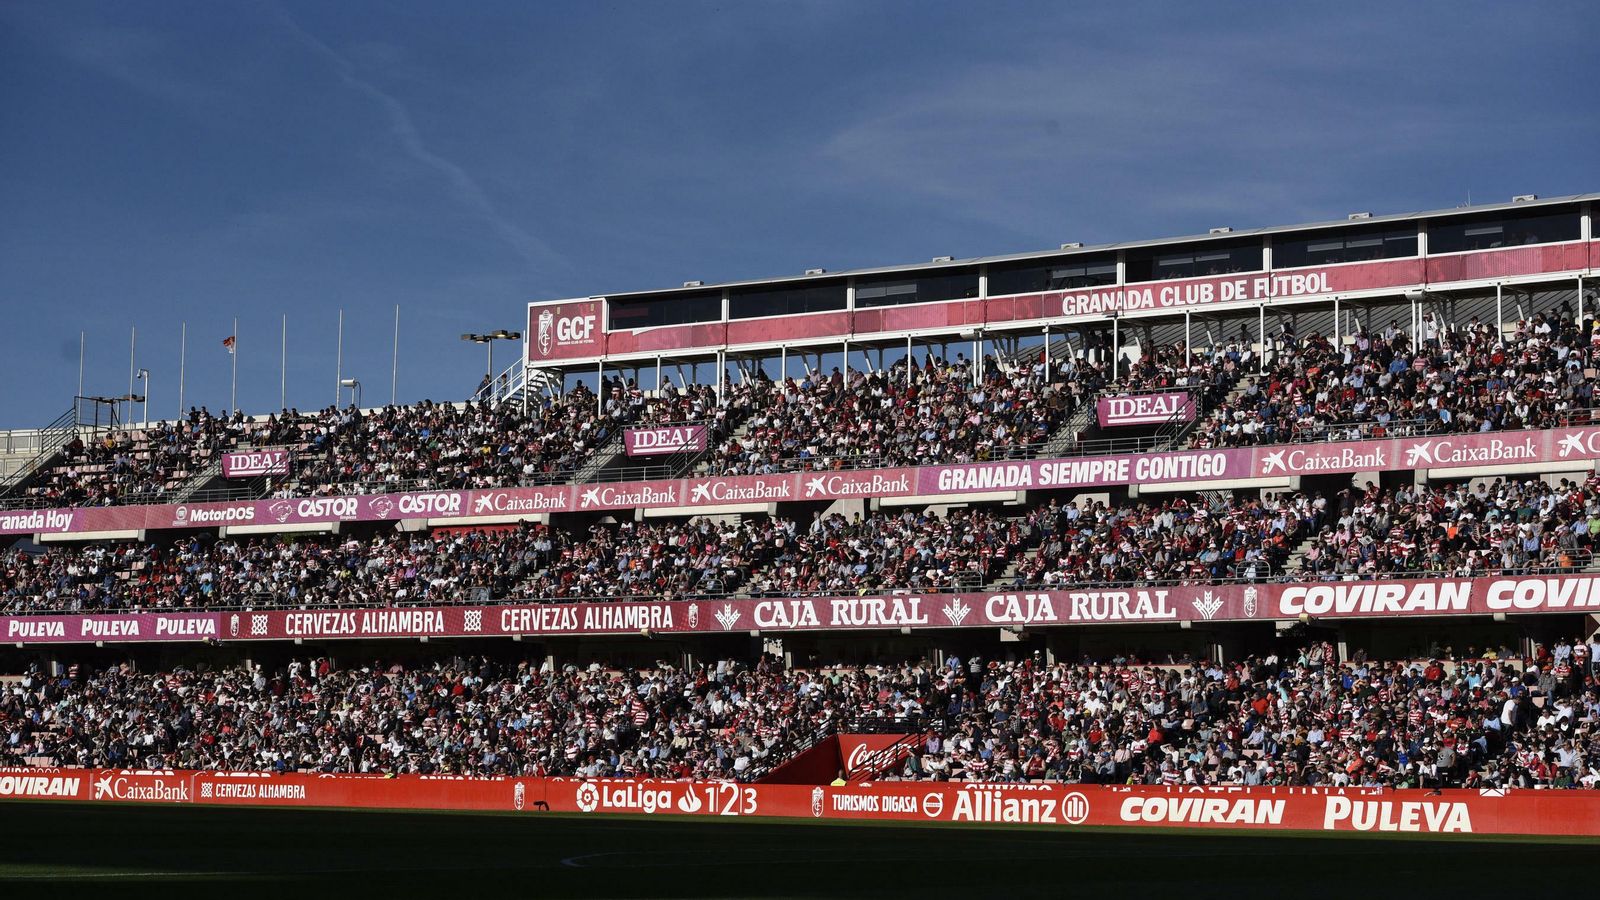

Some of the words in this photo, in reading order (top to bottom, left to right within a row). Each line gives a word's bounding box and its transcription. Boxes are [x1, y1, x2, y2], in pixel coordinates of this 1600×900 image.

[1061, 290, 1154, 316] GRANADA
[1160, 282, 1214, 307] CLUB
[1220, 279, 1247, 301] DE
[1253, 271, 1333, 298] FÚTBOL
[557, 315, 596, 341] GCF
[1107, 395, 1186, 418] IDEAL
[633, 428, 698, 448] IDEAL
[229, 452, 286, 471] IDEAL
[1287, 447, 1386, 472] CaixaBank
[1434, 440, 1537, 466] CaixaBank
[938, 464, 1032, 491] GRANADA
[1039, 459, 1130, 486] SIEMPRE
[1136, 452, 1227, 481] CONTIGO
[602, 486, 676, 506] CaixaBank
[711, 480, 790, 501] CaixaBank
[827, 473, 910, 496] CaixaBank
[297, 498, 358, 517] CASTOR
[398, 493, 461, 513] CASTOR
[494, 493, 566, 512] CaixaBank
[46, 511, 73, 532] Hoy
[190, 507, 255, 522] MotorDOS
[985, 593, 1057, 624] CAJA
[1069, 590, 1176, 621] RURAL
[1279, 582, 1472, 615] COVIRAN
[285, 611, 358, 635] CERVEZAS
[362, 610, 445, 634] ALHAMBRA
[501, 607, 578, 632] CERVEZAS
[584, 604, 673, 631] ALHAMBRA
[753, 600, 820, 629] CAJA
[830, 597, 928, 627] RURAL
[9, 619, 65, 638] PULEVA
[81, 618, 140, 636] PULEVA
[156, 617, 216, 635] PULEVA
[114, 777, 189, 800] CaixaBank
[216, 783, 256, 798] CERVEZAS
[259, 784, 306, 799] ALHAMBRA
[602, 783, 672, 813] LaLiga
[832, 795, 879, 812] TURISMOS
[882, 796, 918, 813] DIGASA
[952, 790, 1057, 823] Allianz
[1120, 797, 1286, 825] COVIRAN
[1323, 796, 1473, 833] PULEVA
